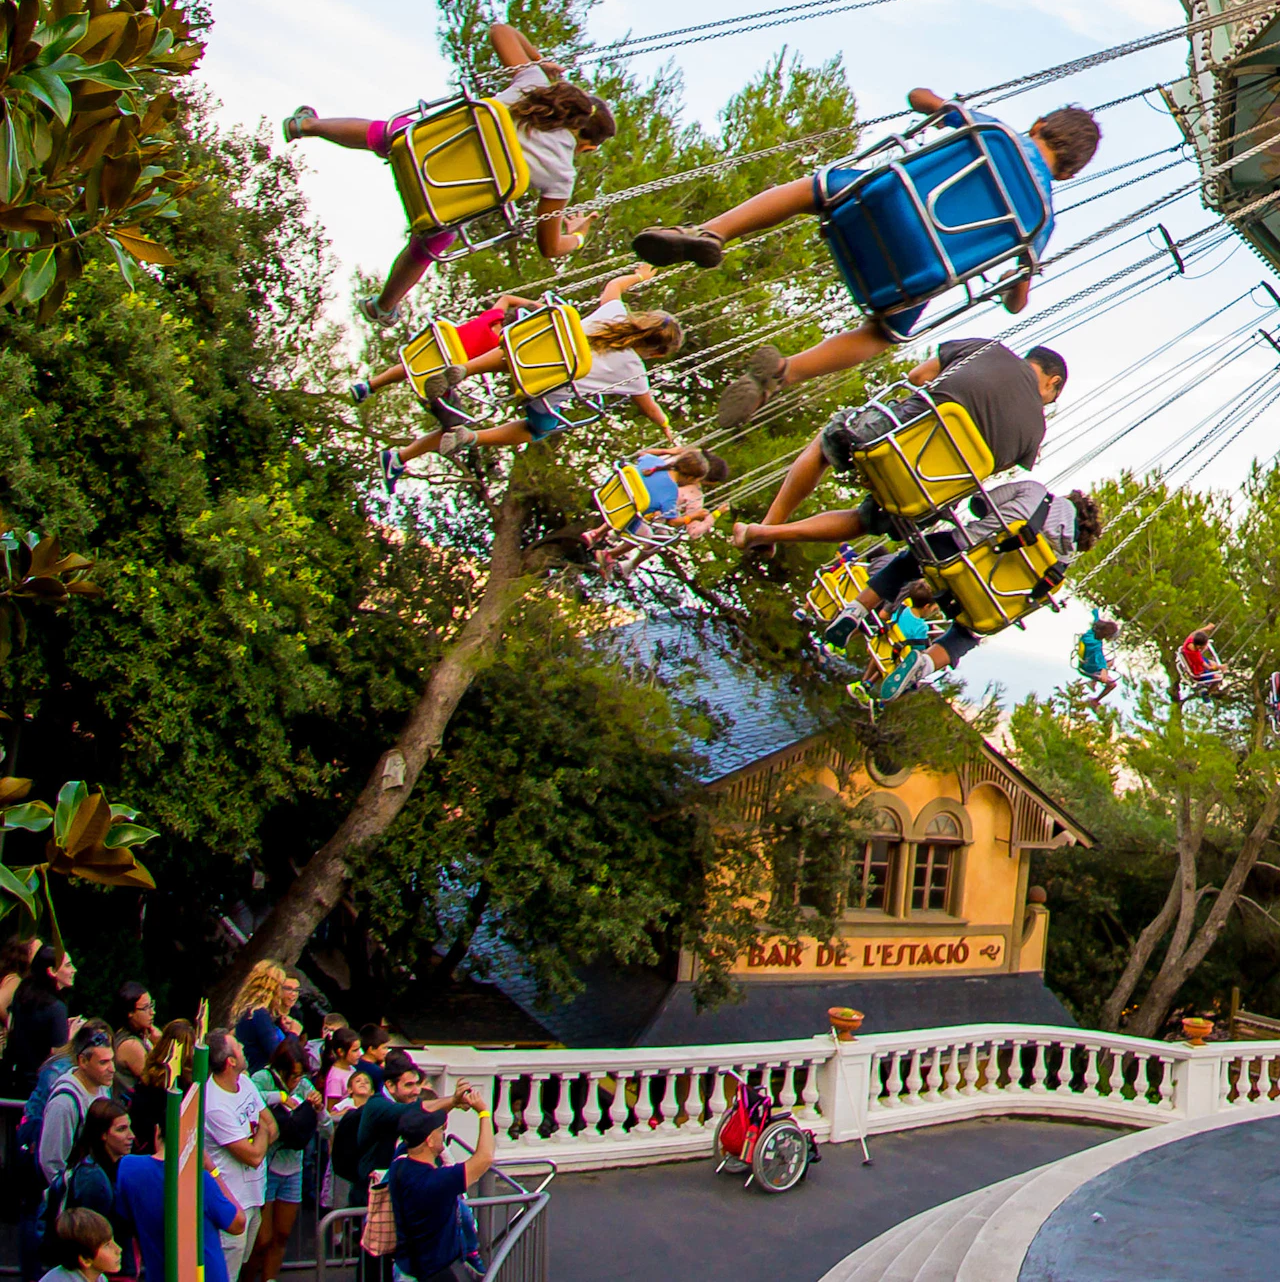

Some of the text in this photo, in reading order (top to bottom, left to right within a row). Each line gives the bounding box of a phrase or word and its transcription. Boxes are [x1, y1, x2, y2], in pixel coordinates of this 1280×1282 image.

[748, 936, 970, 967] BAR DE L'ESTACIÓ
